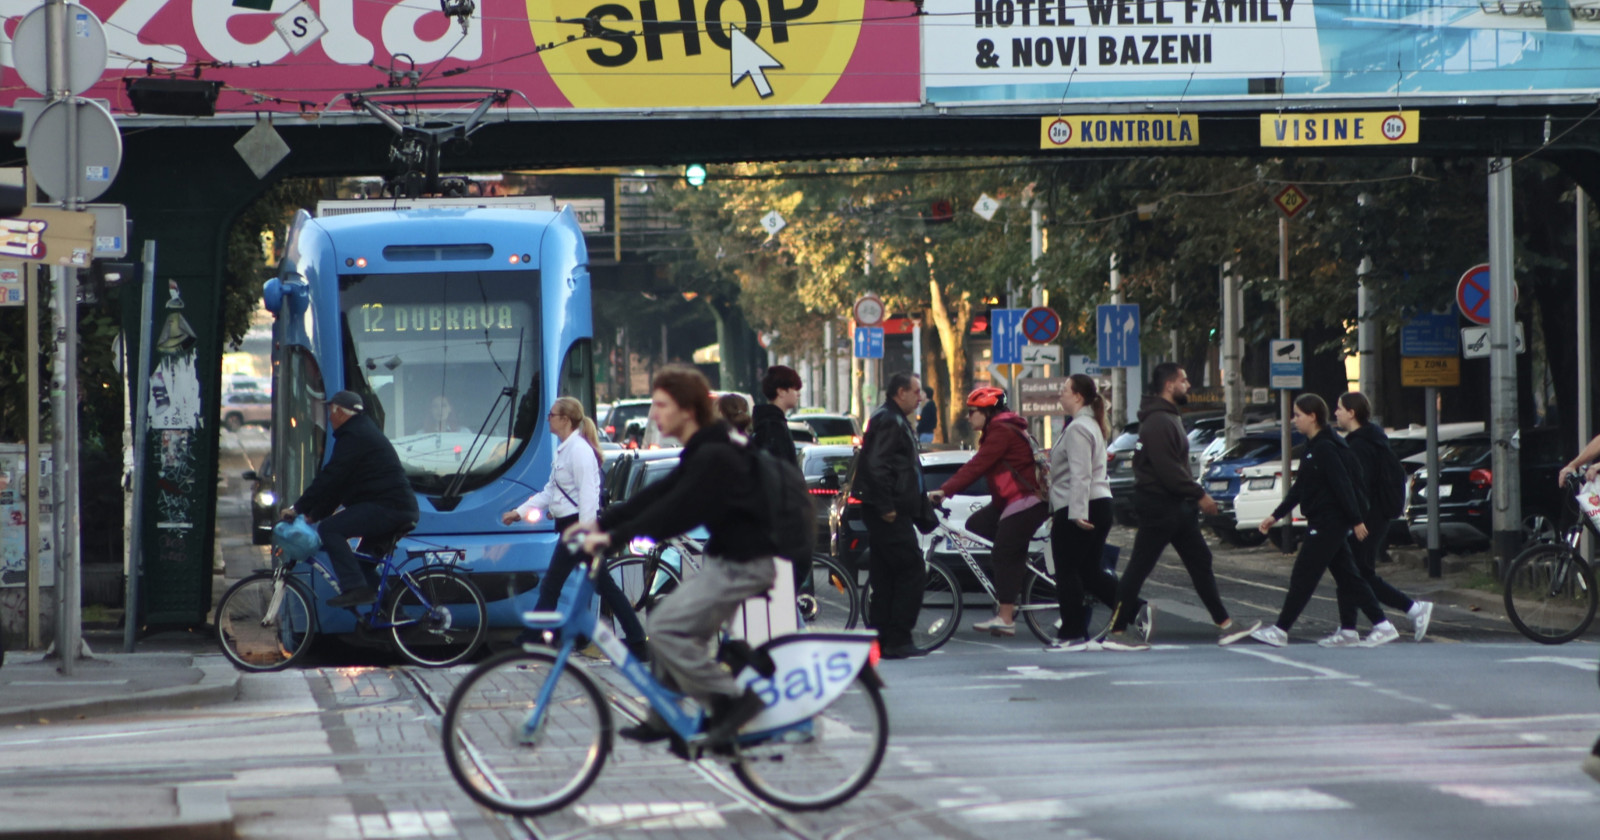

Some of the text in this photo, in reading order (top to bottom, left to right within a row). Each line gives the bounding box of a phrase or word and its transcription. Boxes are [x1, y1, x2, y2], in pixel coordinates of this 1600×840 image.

[974, 0, 1295, 28] HOTEL WELL FAMILY
[291, 16, 308, 38] S
[585, 0, 819, 67] SHOP
[975, 34, 1213, 68] & NOVI BAZENI
[1081, 119, 1193, 143] KONTROLA
[1274, 118, 1364, 141] VISINE
[1285, 193, 1297, 206] 20
[769, 217, 777, 228] S
[360, 303, 513, 332] 12 DUBRAVA
[1425, 360, 1448, 369] ZONA
[1021, 382, 1047, 393] Stadion
[746, 651, 853, 709] Bajs
